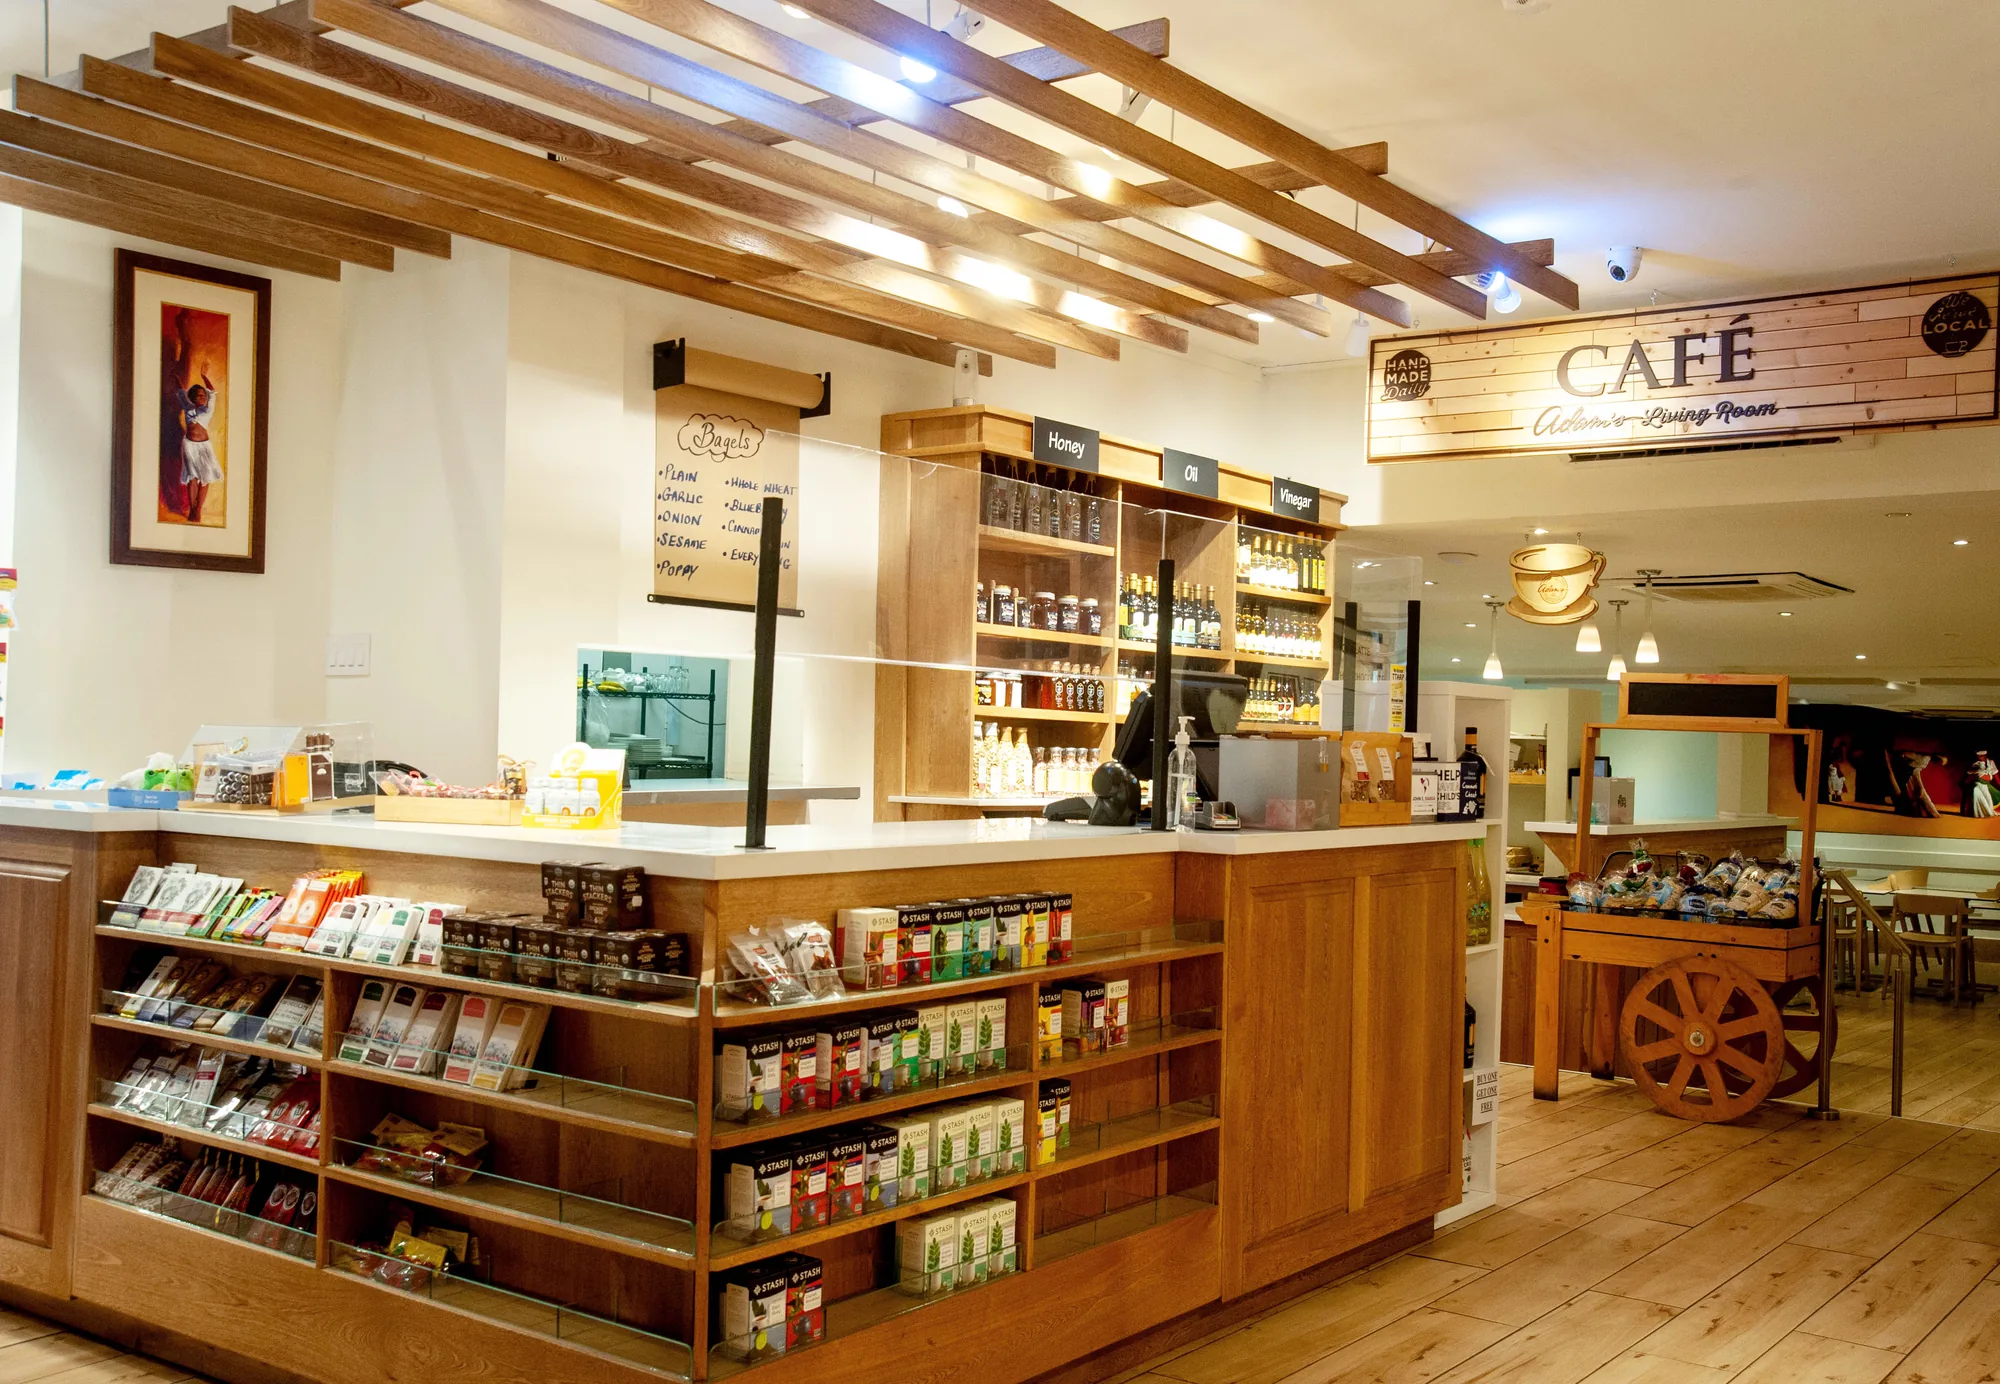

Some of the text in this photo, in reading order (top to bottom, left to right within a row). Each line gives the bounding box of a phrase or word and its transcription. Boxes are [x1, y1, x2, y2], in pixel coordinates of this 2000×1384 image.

[1923, 318, 1989, 335] LOCAL
[1556, 313, 1755, 398] CAFÉ
[1387, 357, 1429, 371] HAND
[1386, 370, 1428, 385] MADE
[1381, 383, 1428, 401] Daily
[1641, 405, 1712, 429] Living
[1715, 400, 1780, 424] Room
[692, 421, 751, 456] Bagels
[1048, 431, 1085, 459] Honey
[664, 463, 699, 482] PLAIN
[1184, 464, 1198, 483] Oil
[730, 477, 798, 496] WHOLE WHEAT
[662, 487, 704, 504] GARLIC
[1280, 487, 1313, 511] Vinegar
[729, 499, 788, 524] BLUEBY
[662, 510, 702, 526] ONION
[660, 532, 707, 549] SESAME
[551, 880, 566, 889] THIN
[589, 884, 604, 893] THIN
[545, 887, 574, 899] STACKERS
[582, 892, 613, 904] STACKERS
[1004, 904, 1020, 912] STASH
[1031, 901, 1047, 910] STASH
[1057, 898, 1072, 906] STASH
[943, 911, 962, 920] STASH
[974, 906, 990, 916] STASH
[878, 917, 897, 926] STASH
[909, 913, 930, 922] STASH
[452, 934, 465, 942] THIN
[487, 938, 500, 947] THIN
[526, 944, 540, 952] THIN
[564, 950, 578, 958] THIN
[603, 954, 618, 962] THIN
[1044, 994, 1061, 1002] STASH
[1090, 988, 1104, 997] STASH
[956, 1008, 974, 1016] STASH
[986, 1004, 1004, 1012] STASH
[902, 1016, 918, 1027] STASH
[926, 1012, 943, 1022] STASH
[878, 1022, 893, 1034] STASH
[842, 1029, 860, 1040] STASH
[794, 1035, 816, 1047] STASH
[758, 1042, 779, 1054] STASH
[1477, 1071, 1498, 1083] BUY ONE
[1055, 1086, 1070, 1096] STASH
[1476, 1086, 1498, 1098] GET ONE
[1038, 1098, 1056, 1108] STASH
[1481, 1101, 1493, 1112] FREE
[975, 1112, 991, 1122] STASH
[1006, 1106, 1022, 1117] STASH
[947, 1119, 965, 1130] STASH
[909, 1128, 928, 1140] STASH
[878, 1135, 897, 1148] STASH
[840, 1142, 862, 1156] STASH
[804, 1150, 826, 1164] STASH
[766, 1158, 789, 1172] STASH
[998, 1208, 1014, 1218] STASH
[969, 1216, 986, 1228] STASH
[935, 1224, 952, 1236] STASH
[800, 1266, 820, 1280] STASH
[762, 1278, 784, 1292] STASH
